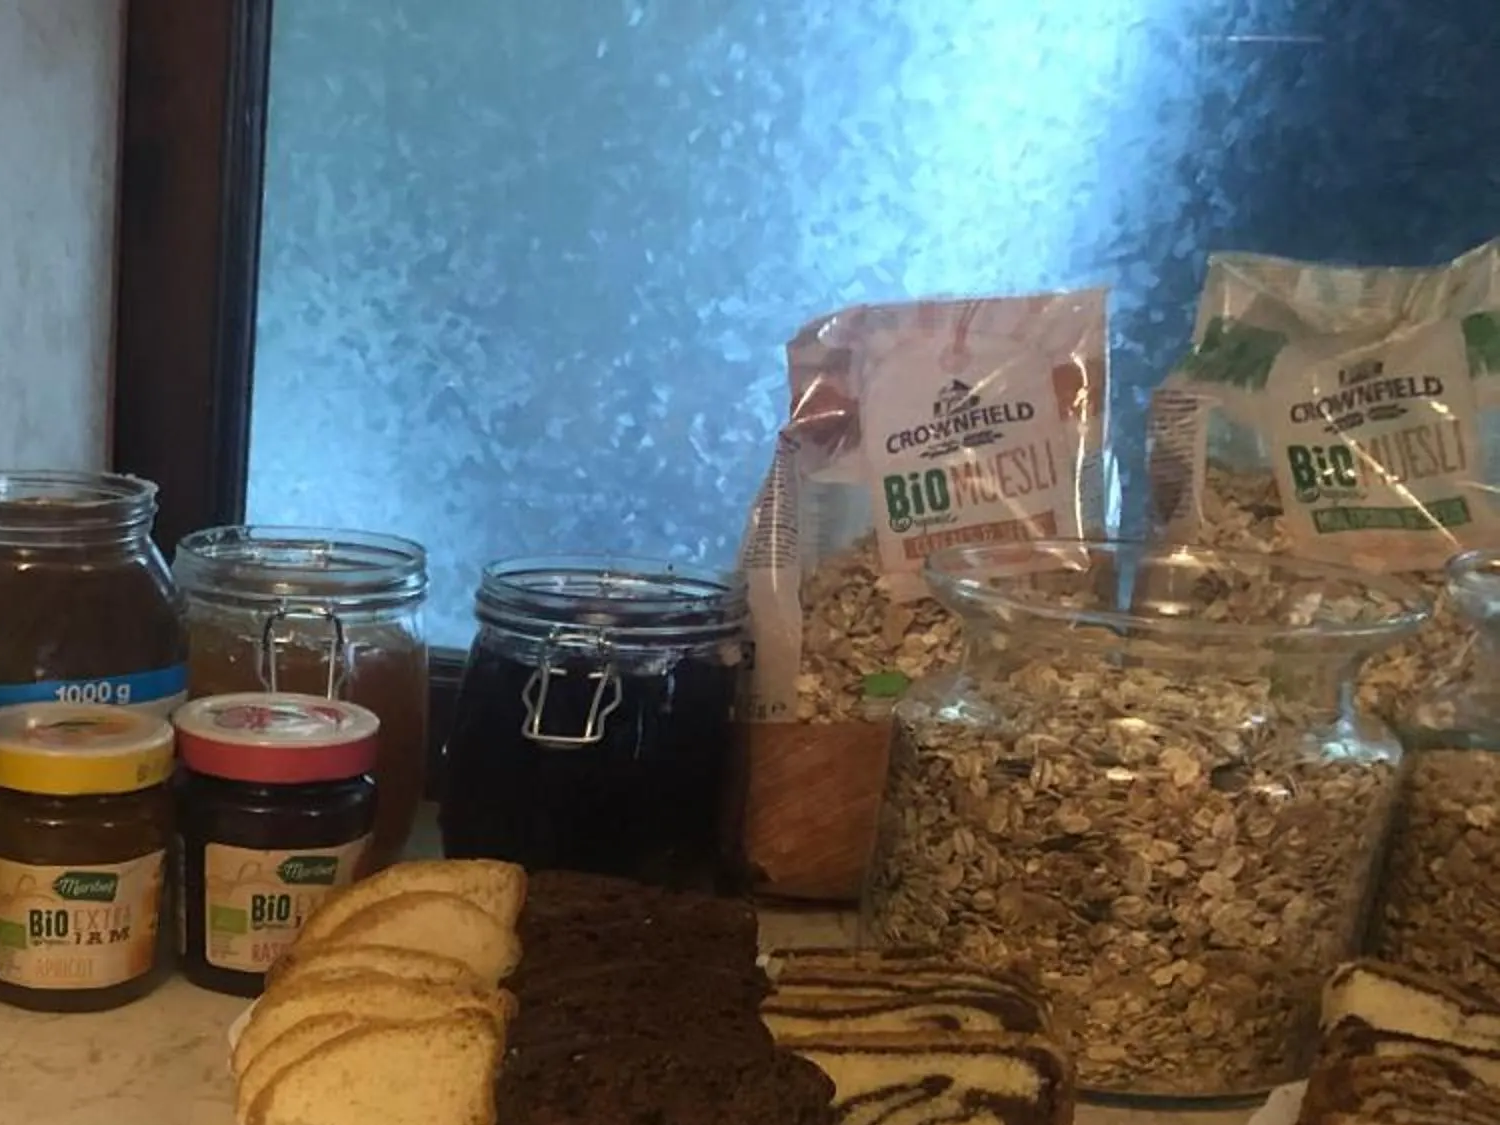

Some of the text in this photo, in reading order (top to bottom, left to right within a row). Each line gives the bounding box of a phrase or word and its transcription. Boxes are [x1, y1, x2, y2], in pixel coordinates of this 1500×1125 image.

[1290, 376, 1444, 424] CROWNFIELD
[886, 402, 1035, 454] CROWNFIELD
[54, 681, 131, 704] 1000 g
